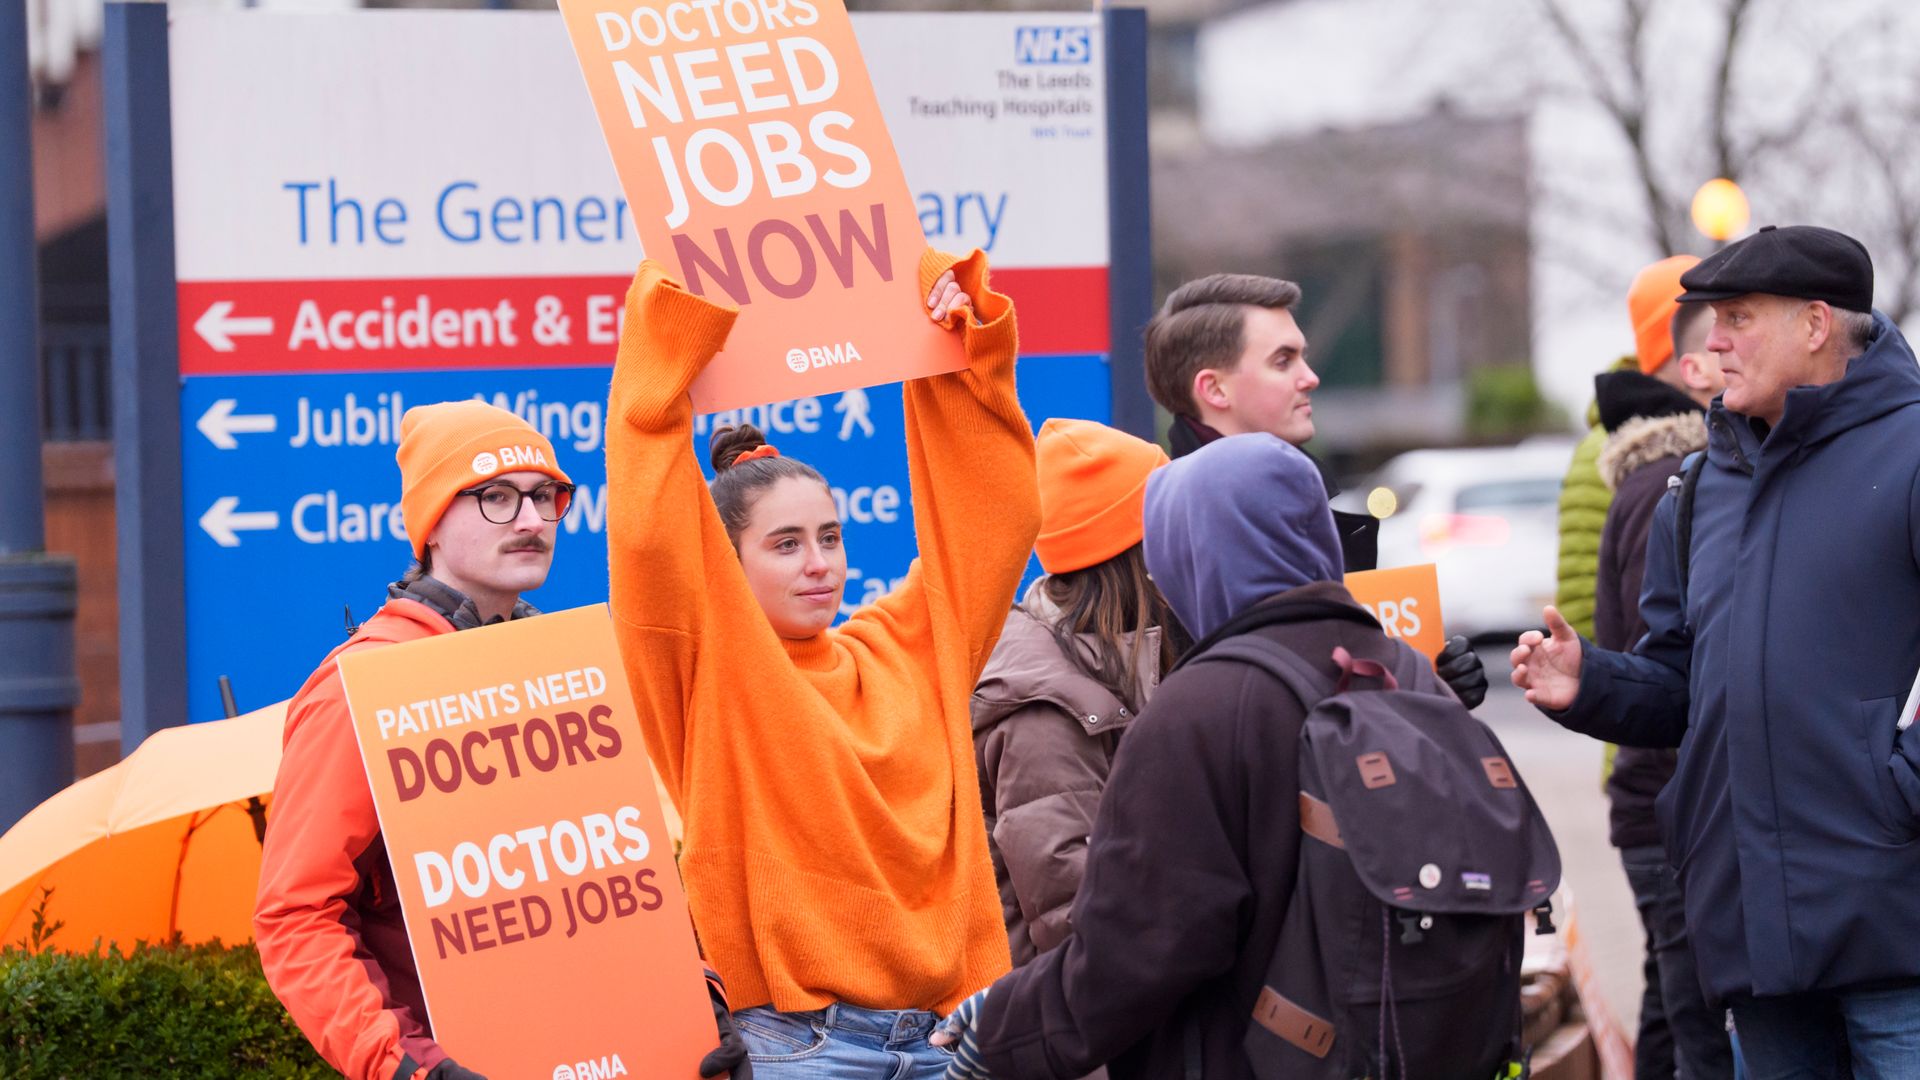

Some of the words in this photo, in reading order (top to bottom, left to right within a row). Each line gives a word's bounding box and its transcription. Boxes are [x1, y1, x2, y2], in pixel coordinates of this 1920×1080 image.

[595, 0, 819, 51] DOCTORS
[1017, 27, 1090, 64] NHS
[612, 36, 839, 128] NEED
[998, 70, 1032, 89] The
[1037, 71, 1092, 89] Leeds
[909, 96, 997, 120] Teaching
[1002, 98, 1093, 118] Hospitals
[652, 111, 871, 229] JOBS
[283, 178, 407, 244] The
[672, 204, 893, 305] NOW
[289, 295, 516, 350] Accident
[533, 296, 570, 345] &
[808, 342, 862, 369] BMA
[499, 446, 548, 468] BMA
[1362, 597, 1421, 637] RS
[376, 684, 520, 739] PATIENTS
[524, 667, 607, 709] NEED
[387, 705, 622, 802] DOCTORS
[414, 806, 649, 907] DOCTORS
[431, 896, 552, 959] NEED
[562, 869, 663, 938] JOBS
[575, 1054, 628, 1080] BMA
